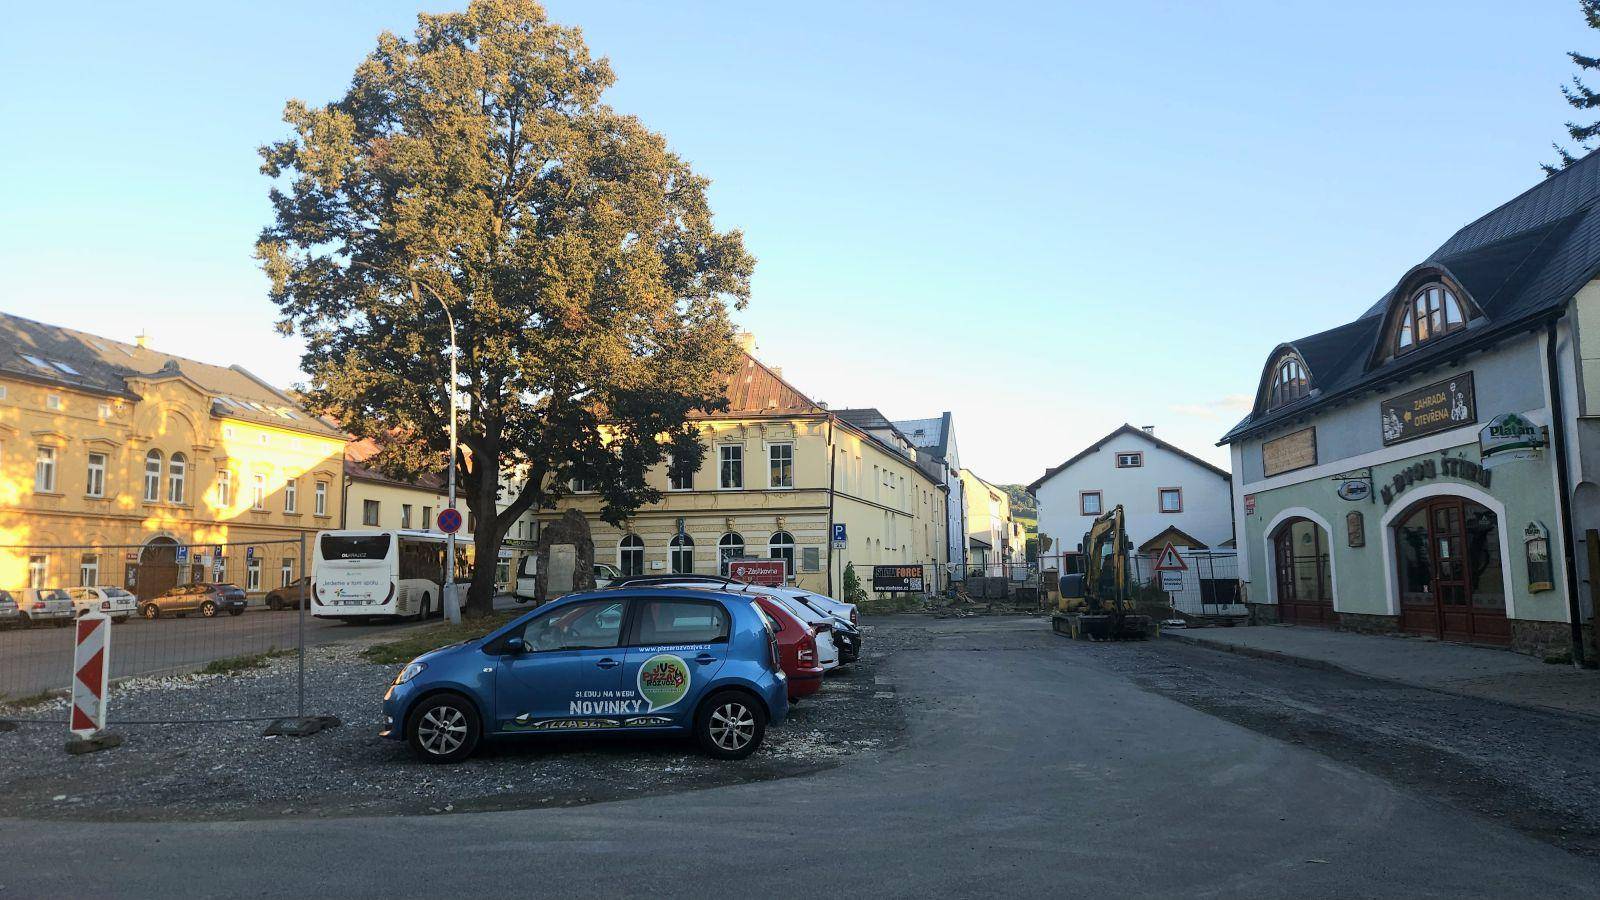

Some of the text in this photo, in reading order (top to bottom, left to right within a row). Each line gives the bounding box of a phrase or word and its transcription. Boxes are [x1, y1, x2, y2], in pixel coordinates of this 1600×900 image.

[1414, 391, 1447, 411] ZAHRADA
[1414, 408, 1450, 427] OTEVŘENA
[836, 525, 843, 536] P
[575, 690, 601, 698] SLEDUJ
[603, 690, 613, 698] NA
[569, 700, 642, 715] NOVINKY
